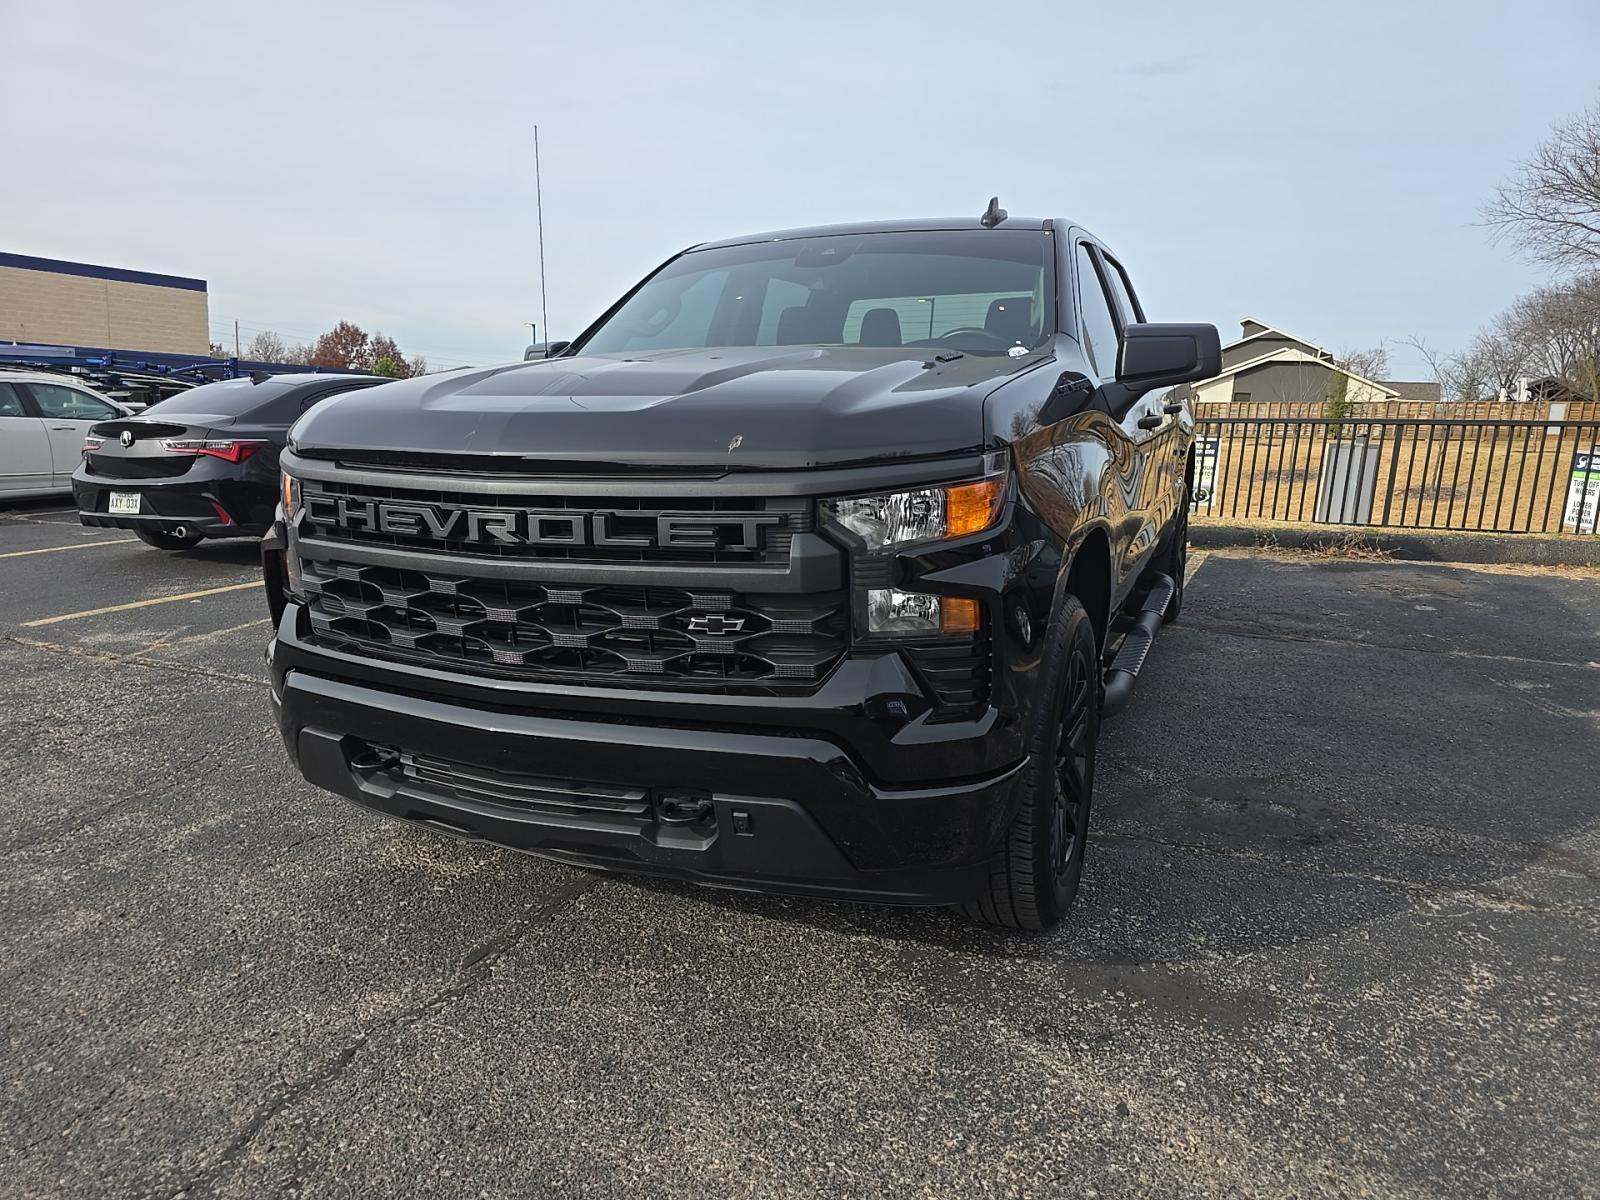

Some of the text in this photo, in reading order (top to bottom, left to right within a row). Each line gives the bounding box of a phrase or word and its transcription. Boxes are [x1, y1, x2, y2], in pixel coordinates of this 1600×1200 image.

[1575, 487, 1596, 497] WIERS
[1573, 500, 1592, 510] LOER
[1571, 508, 1591, 517] POER
[303, 497, 788, 550] CHEVROLET
